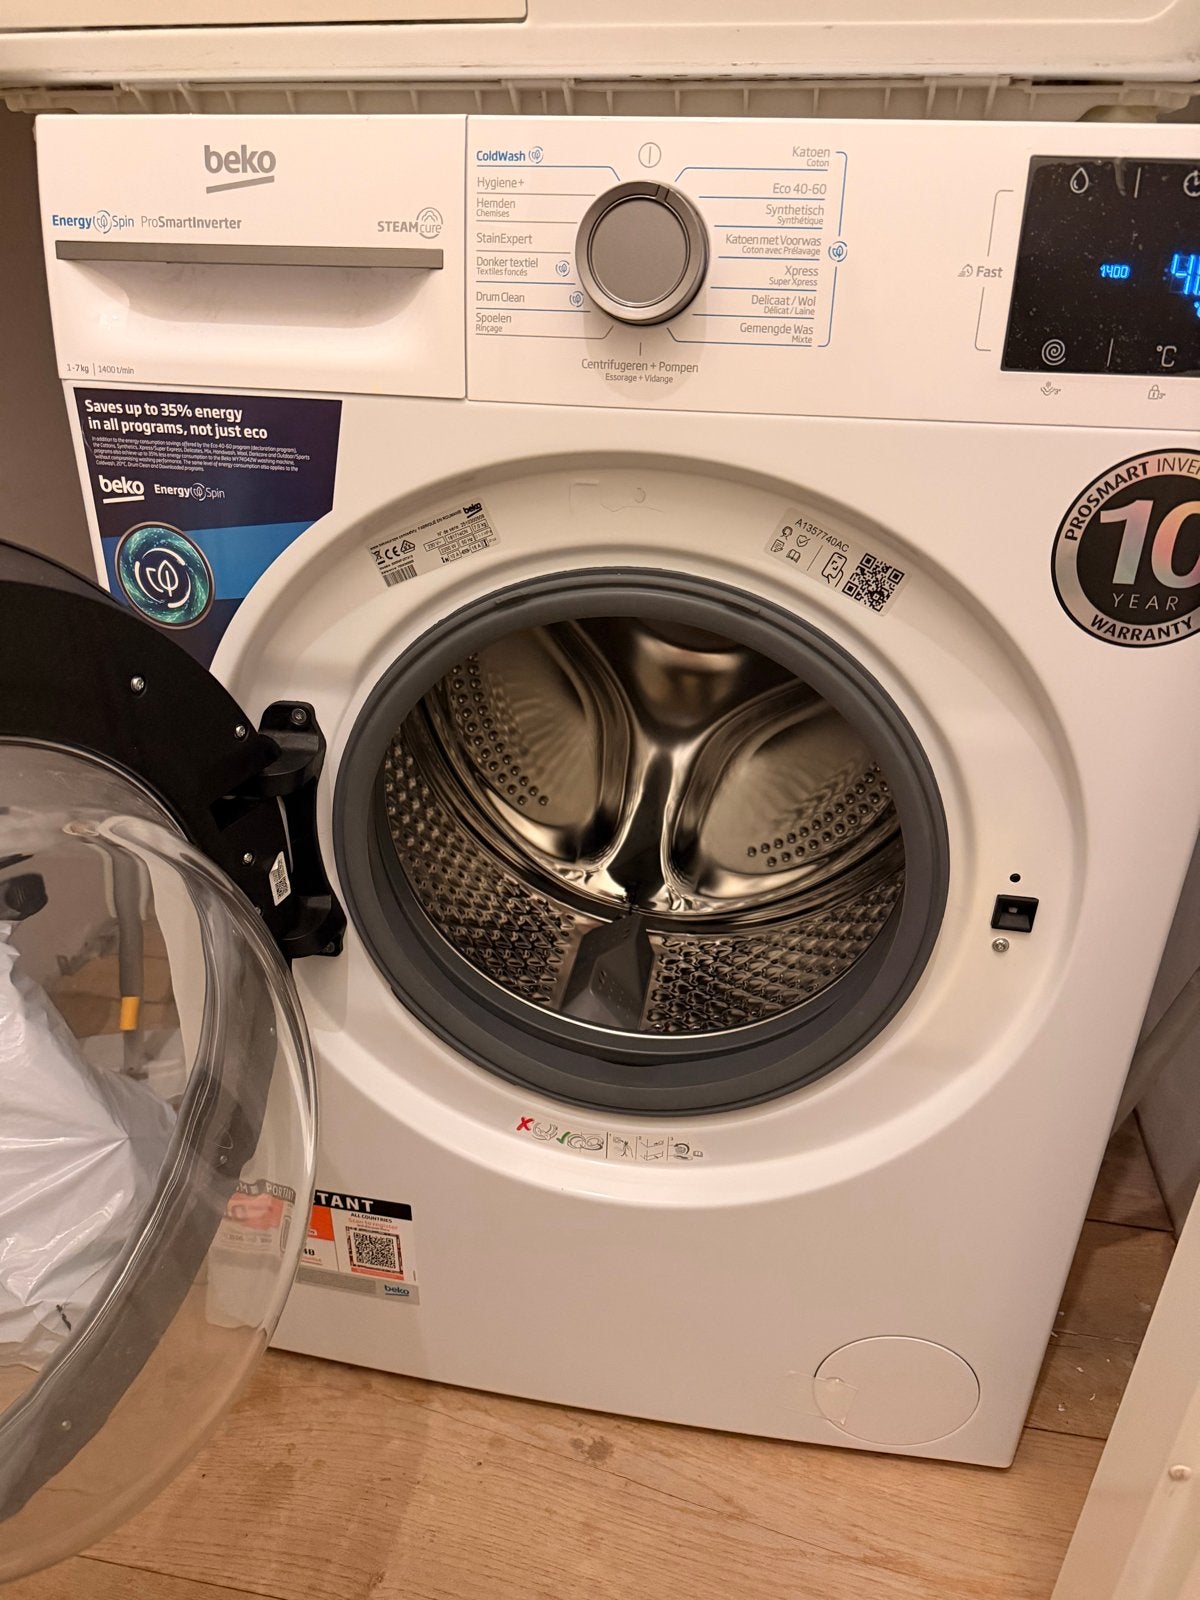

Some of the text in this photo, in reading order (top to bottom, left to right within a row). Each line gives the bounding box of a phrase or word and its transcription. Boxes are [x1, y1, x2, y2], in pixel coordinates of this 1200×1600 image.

[476, 151, 526, 162] ColdWash
[792, 146, 831, 158] Katoen
[204, 144, 277, 174] beko
[806, 158, 830, 167] Coton
[477, 177, 525, 190] Hygiene+
[772, 183, 827, 195] Eco 40-60
[476, 198, 516, 209] Hemden
[476, 209, 510, 218] Chemises
[765, 204, 825, 218] Synthetisch
[52, 214, 242, 230] Energy Spin ProSmartInverter
[777, 216, 824, 226] Synthétique
[476, 233, 533, 246] StainExpert
[725, 234, 822, 247] Katoen met Voorwas
[742, 246, 821, 257] Coton avec Prélavage
[476, 256, 539, 268] Donker textiel
[476, 267, 528, 277] Textiles foncés
[785, 266, 819, 279] Xpress
[976, 266, 1003, 278] Fast
[1100, 264, 1131, 279] 1400
[769, 277, 818, 288] Super Xpress
[476, 291, 525, 303] Drum Clean
[751, 295, 790, 306] Delicaat
[796, 296, 816, 307] Wol
[764, 306, 790, 315] Délicat
[795, 307, 815, 316] Laine
[476, 312, 512, 324] Spoelen
[475, 324, 503, 333] Rinçage
[739, 323, 814, 337] Gemengde Was
[791, 335, 813, 344] Mixte
[98, 364, 116, 374] 1400
[581, 358, 648, 373] Centrifugeren
[658, 361, 699, 375] Pompen
[605, 373, 638, 383] Essorage
[644, 374, 674, 385] Vidange
[84, 399, 243, 423] Saves up to 35% energy
[88, 416, 268, 440] in all programs, not just eco
[98, 474, 145, 495] beko
[154, 484, 226, 500] Energy Spin
[1064, 461, 1150, 541] PROSMART
[462, 502, 482, 514] beko
[795, 518, 850, 553] A1357740AC
[1100, 500, 1200, 589] 10
[1112, 592, 1179, 611] YEAR
[1090, 614, 1193, 641] WARRANTY
[315, 1191, 374, 1213] TANT
[384, 1284, 410, 1295] beko
